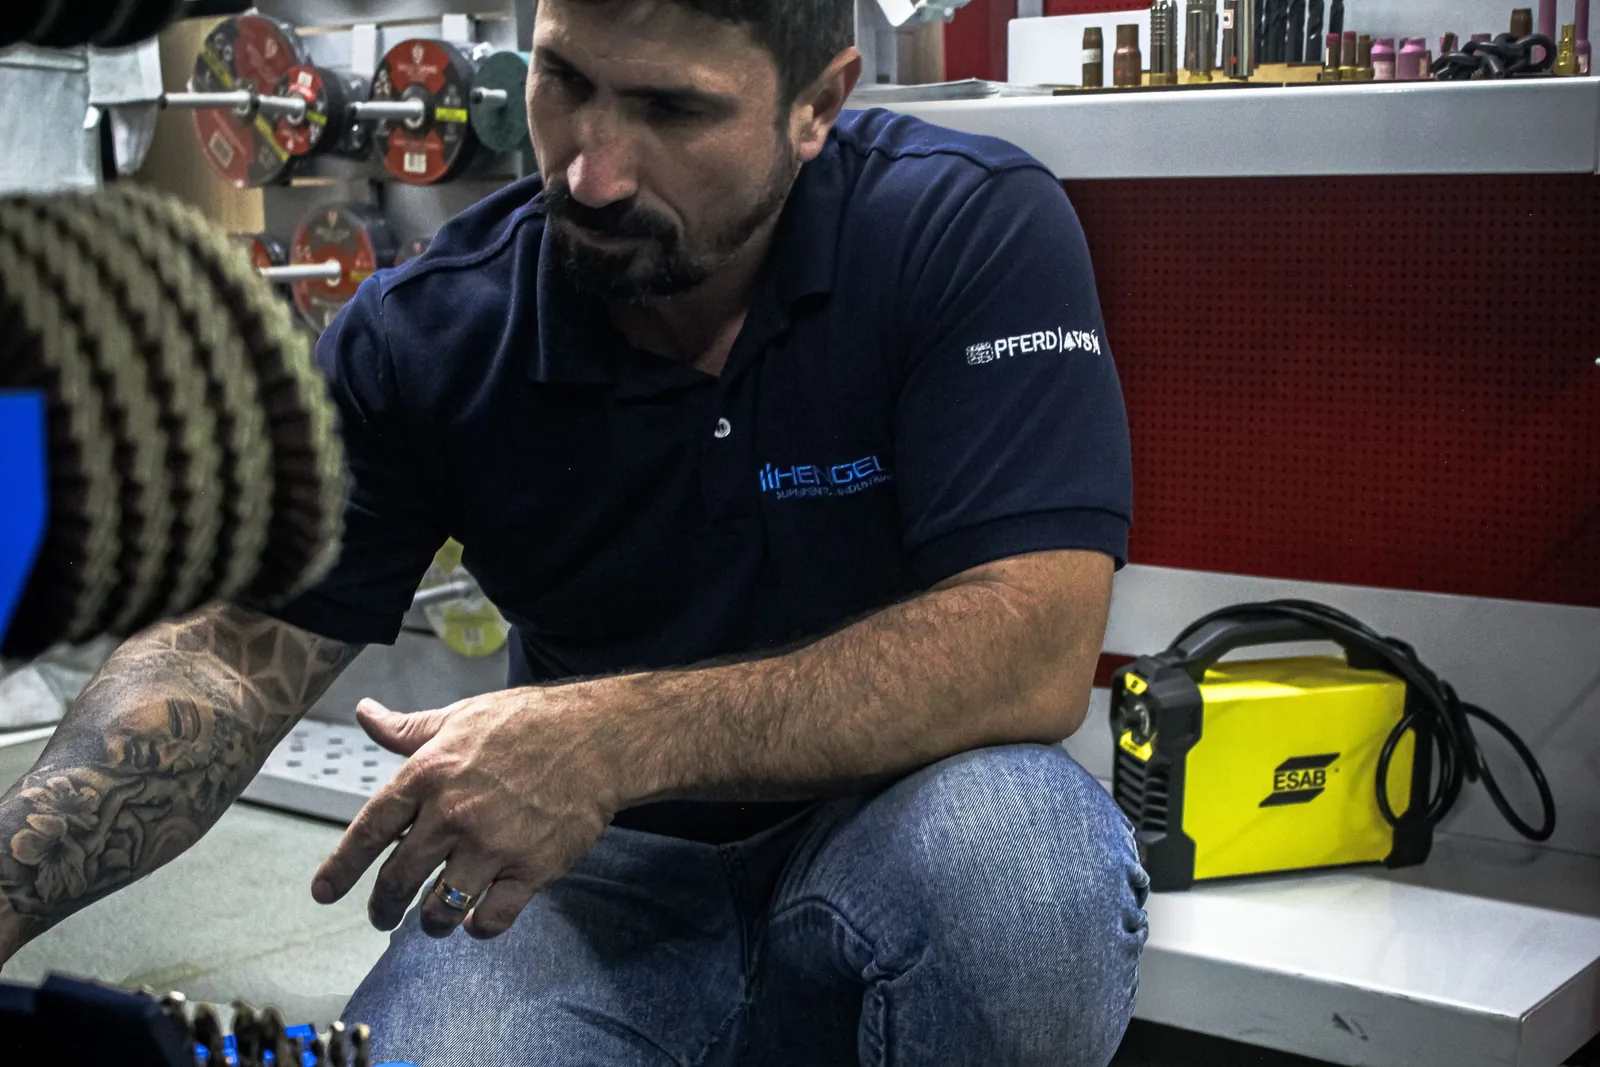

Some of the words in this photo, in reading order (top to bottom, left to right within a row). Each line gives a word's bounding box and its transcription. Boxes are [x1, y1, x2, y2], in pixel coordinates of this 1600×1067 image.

[994, 331, 1058, 360] PFERD
[774, 455, 885, 489] HENGEL
[1273, 769, 1327, 791] ESAB
